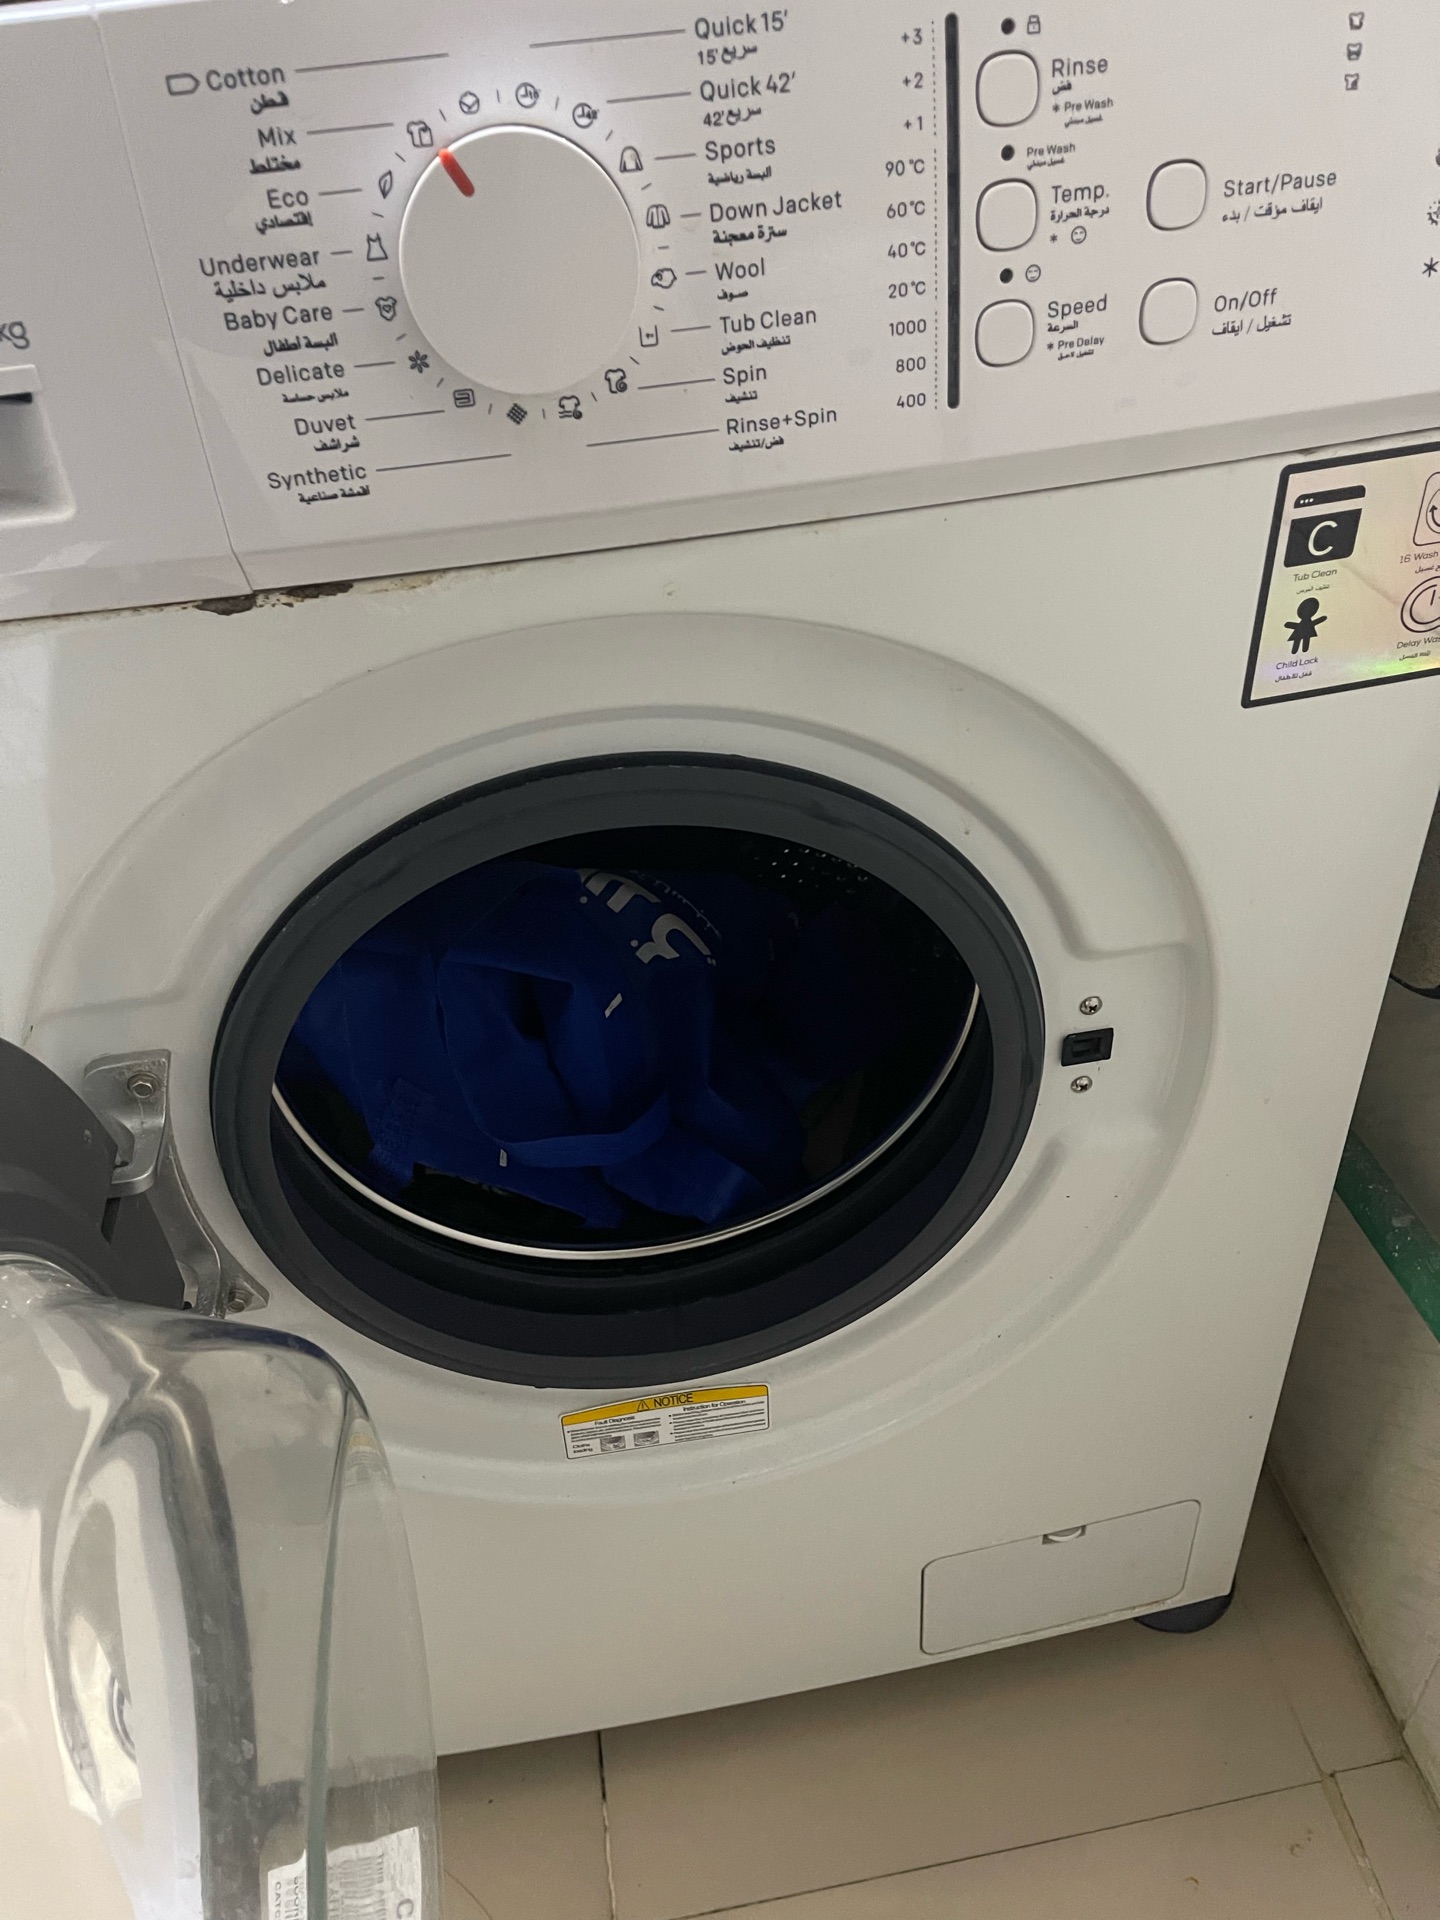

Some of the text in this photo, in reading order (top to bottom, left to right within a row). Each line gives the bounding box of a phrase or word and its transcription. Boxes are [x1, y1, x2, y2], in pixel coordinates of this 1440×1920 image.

[695, 14, 757, 40] Quick
[1052, 58, 1108, 78] Rinse
[206, 67, 285, 91] Cotton
[700, 75, 762, 102] Quick
[251, 91, 289, 115] قطن
[1064, 97, 1114, 112] Pre Wash
[258, 127, 297, 148] Mix
[705, 138, 776, 164] Sports
[1027, 143, 1076, 158] Pre Wash
[250, 155, 301, 175] مختلط
[1052, 184, 1110, 204] Temp.
[1223, 171, 1337, 197] Start/Pause
[267, 188, 309, 209] Eco
[709, 190, 842, 223] Down Jacket
[199, 250, 320, 277] Underwear
[715, 257, 766, 281] Wool
[214, 273, 326, 303] ملابس داخلية
[717, 288, 748, 302] صوف
[1047, 293, 1107, 320] Speed
[1214, 287, 1278, 313] On/Off
[224, 304, 333, 331] Baby Care
[720, 309, 817, 334] Tub Clean
[889, 319, 927, 336] 1000
[1058, 335, 1105, 350] Pre Delay
[257, 362, 345, 386] Delicate
[723, 365, 767, 386] Spin
[896, 357, 926, 373] 800
[896, 393, 926, 408] 400
[294, 414, 357, 436] Duvet
[726, 408, 837, 435] Rinse+Spin
[267, 464, 367, 491] Synthetic
[1414, 551, 1439, 561] Wash
[1293, 569, 1338, 582] Tub Clean
[1396, 639, 1421, 649] Delay
[1276, 656, 1319, 670] Child Lock
[653, 1393, 694, 1409] NOTICE
[683, 1403, 711, 1412] Instruction
[719, 1399, 746, 1407] Operation
